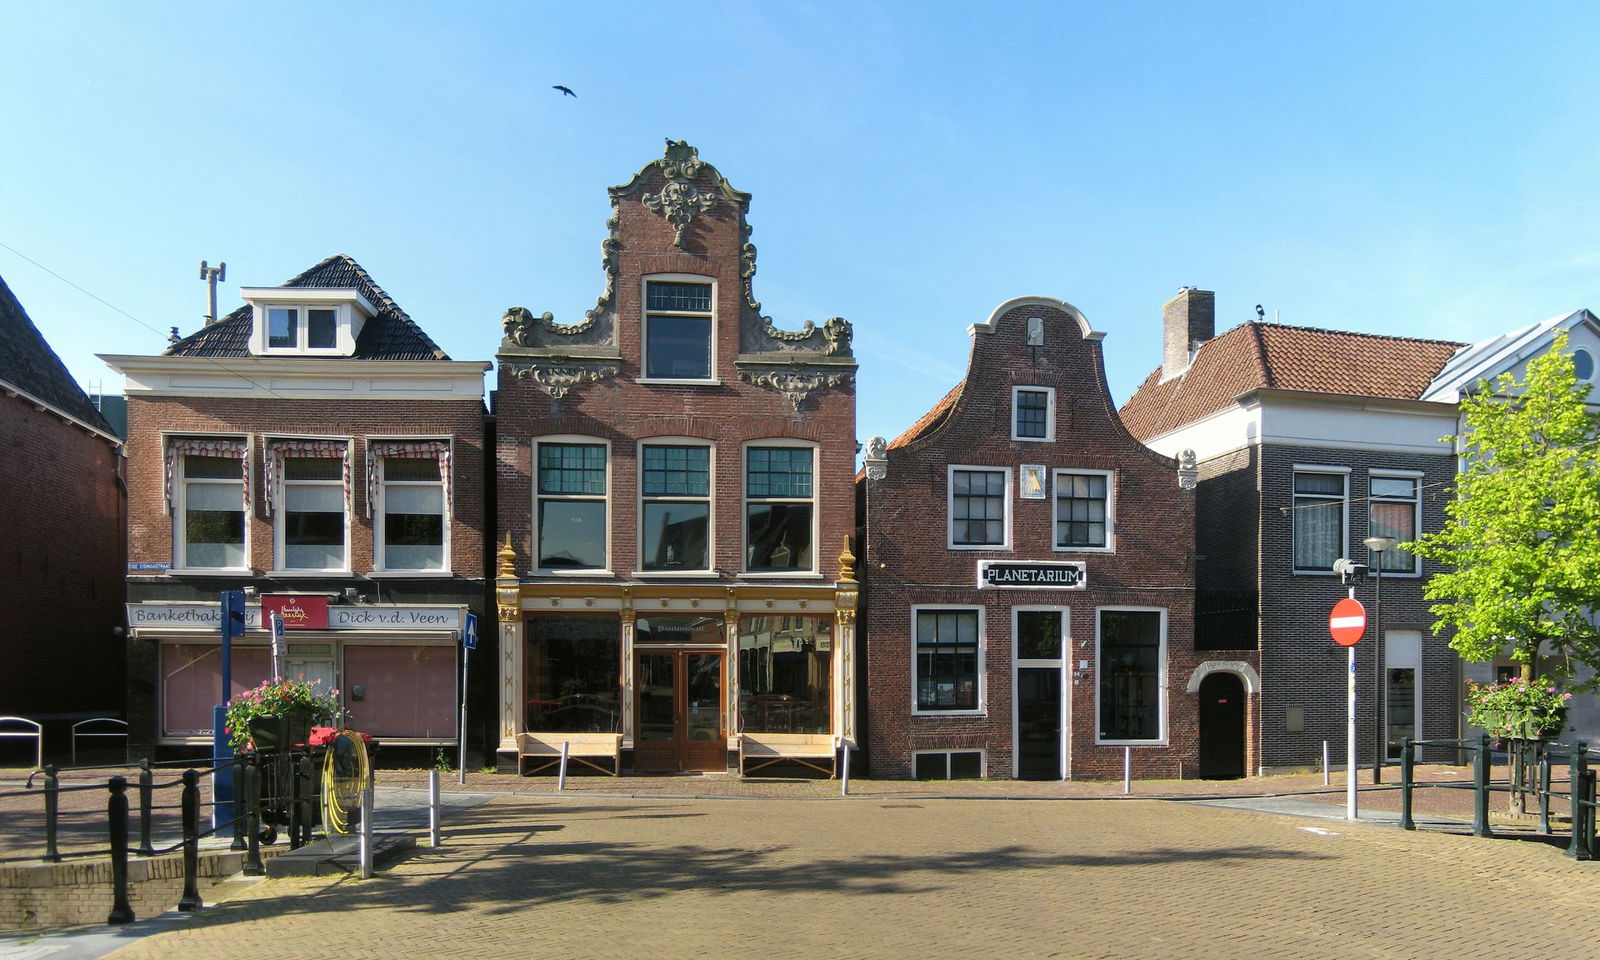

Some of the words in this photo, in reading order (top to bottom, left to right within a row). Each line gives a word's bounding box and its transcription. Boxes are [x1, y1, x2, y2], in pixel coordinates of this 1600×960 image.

[987, 569, 1080, 582] PLANETARIUM
[135, 608, 255, 625] Banketbakij
[337, 610, 375, 623] Dick
[379, 611, 405, 623] v.d.
[410, 611, 449, 624] Veen
